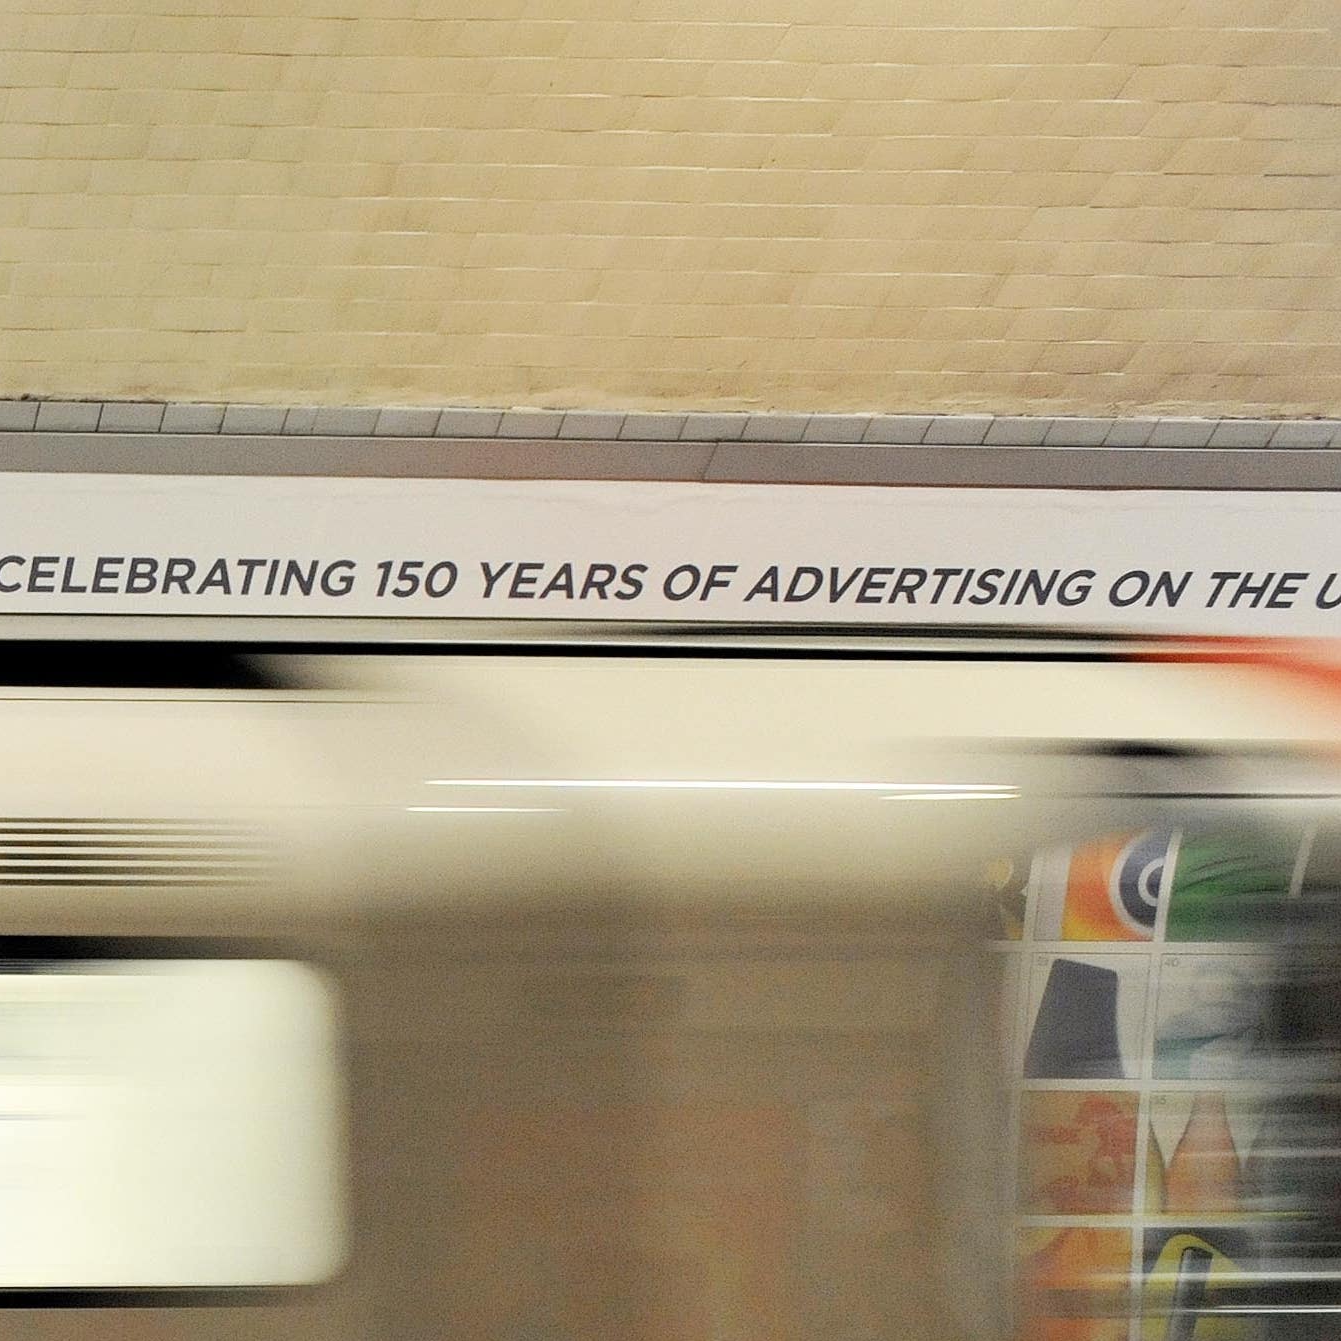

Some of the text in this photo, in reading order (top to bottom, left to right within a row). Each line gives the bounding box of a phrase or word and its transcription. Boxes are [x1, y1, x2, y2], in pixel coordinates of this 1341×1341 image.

[376, 559, 458, 599] 150
[480, 561, 649, 601] YEARS
[662, 563, 739, 602] OF
[742, 565, 1097, 607] ADVERTISING
[1108, 570, 1194, 608] ON
[1205, 571, 1311, 609] THE
